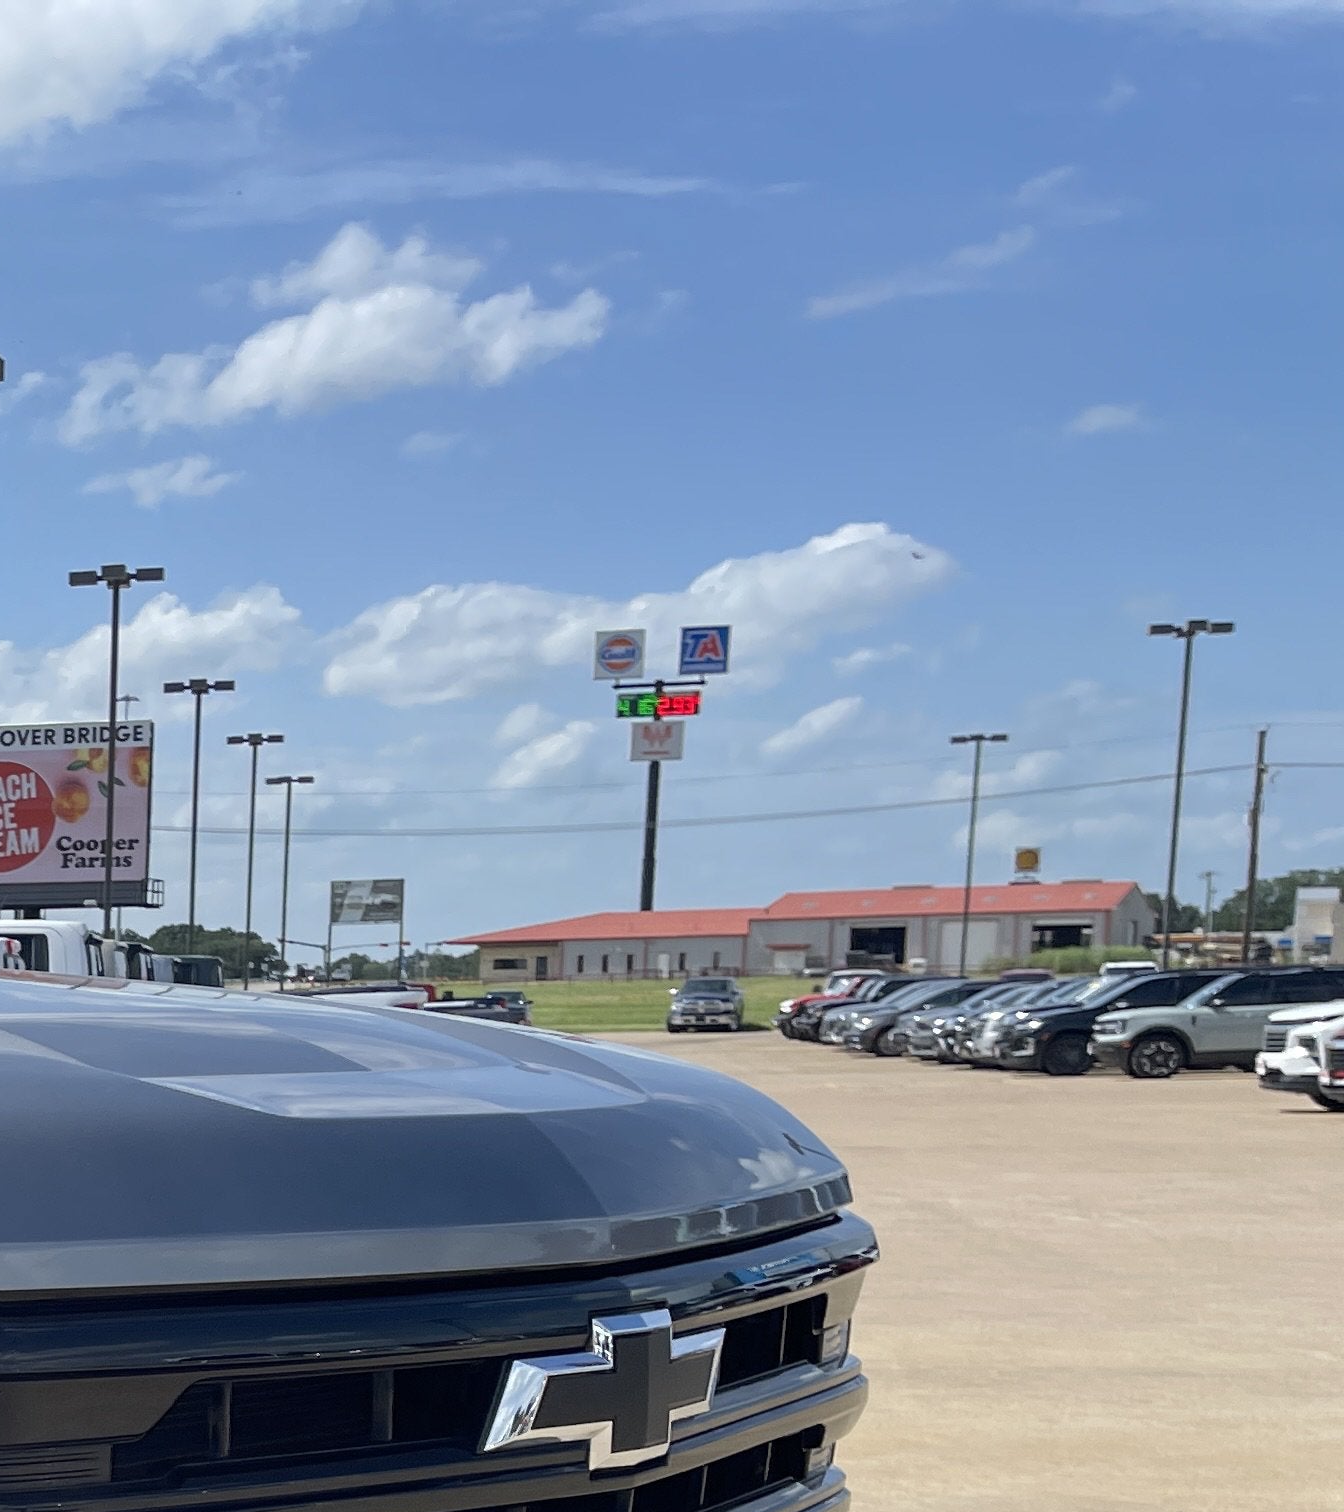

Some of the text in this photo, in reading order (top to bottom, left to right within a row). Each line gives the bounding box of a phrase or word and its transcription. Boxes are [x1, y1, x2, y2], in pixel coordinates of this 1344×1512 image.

[680, 631, 725, 662] TA
[63, 725, 144, 744] BRIDGE
[55, 835, 140, 855] Cooper
[60, 852, 133, 869] Farms
